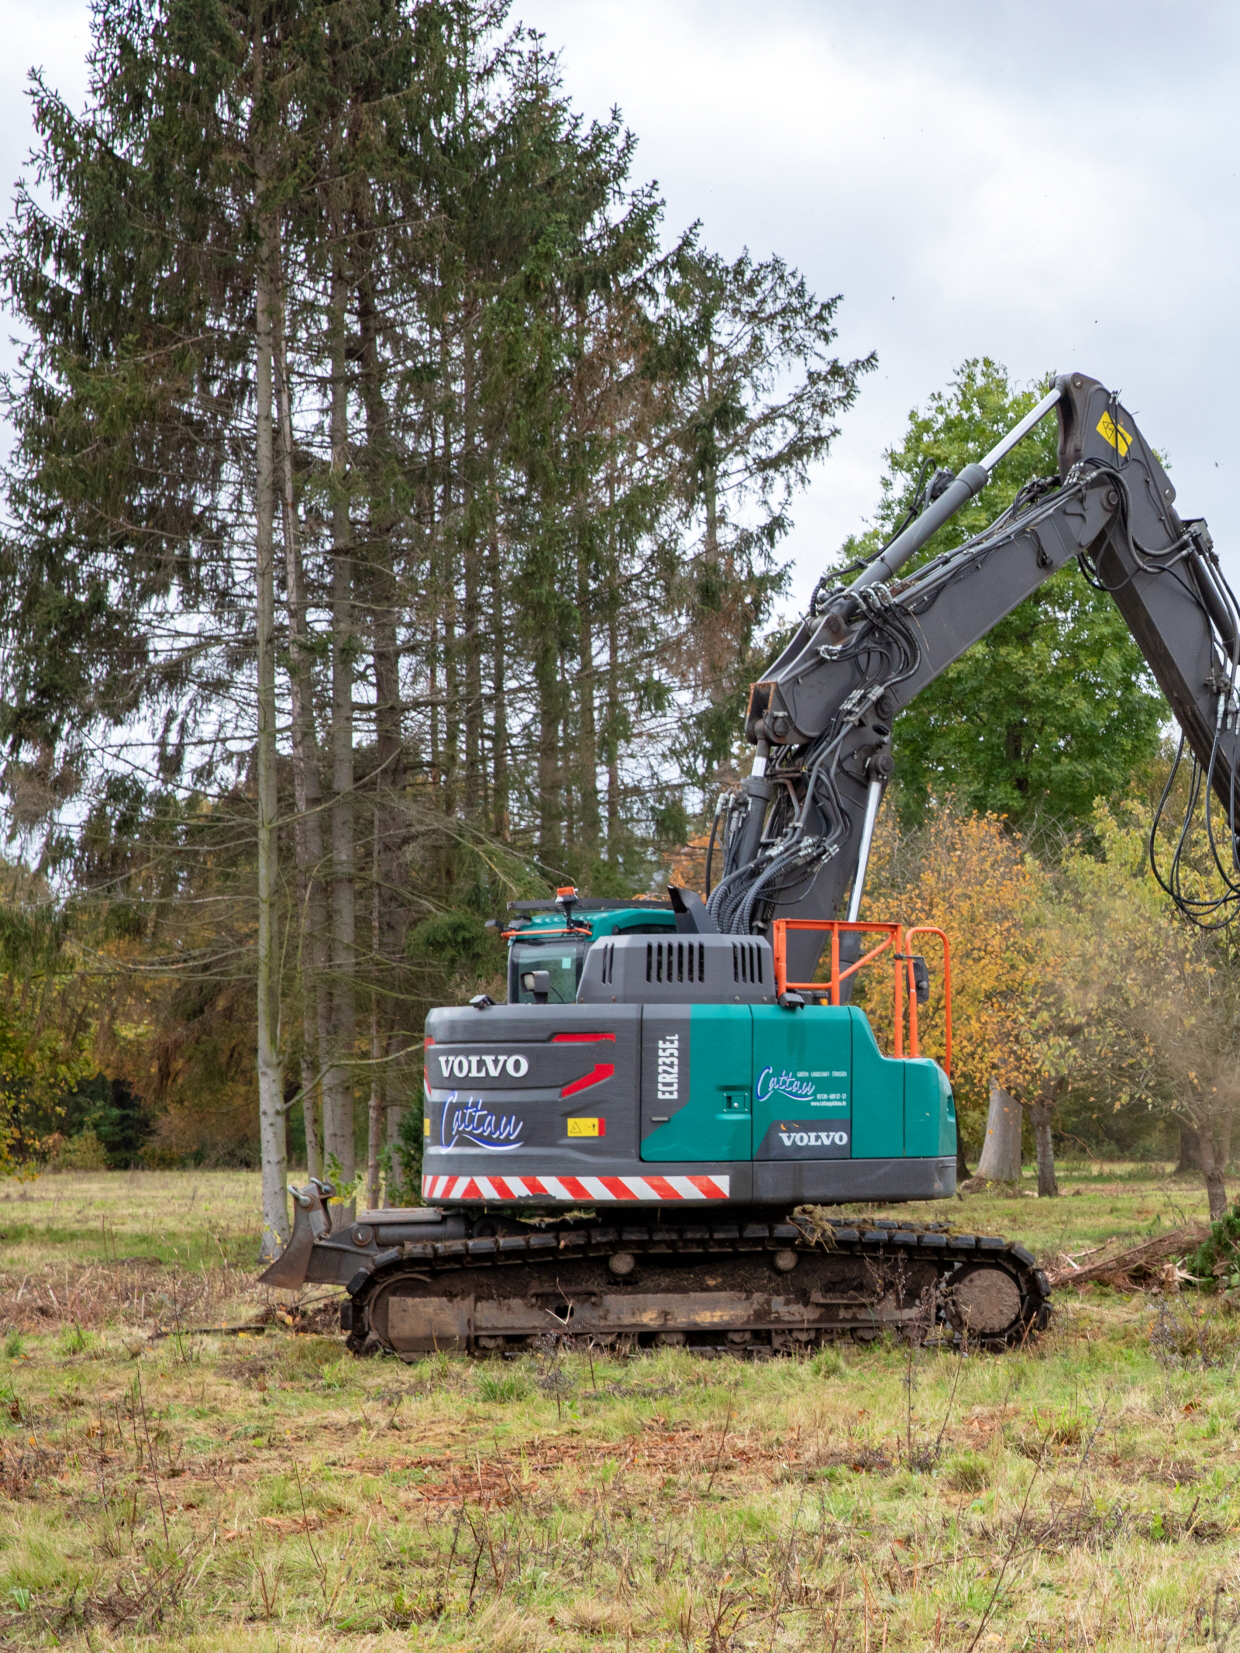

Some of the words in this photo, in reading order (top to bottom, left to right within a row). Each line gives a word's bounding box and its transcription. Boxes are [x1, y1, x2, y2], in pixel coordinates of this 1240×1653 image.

[439, 1054, 529, 1078] VOLVO
[756, 1066, 815, 1101] Cattau
[440, 1090, 523, 1154] Cattau
[779, 1131, 848, 1146] VOLVO
